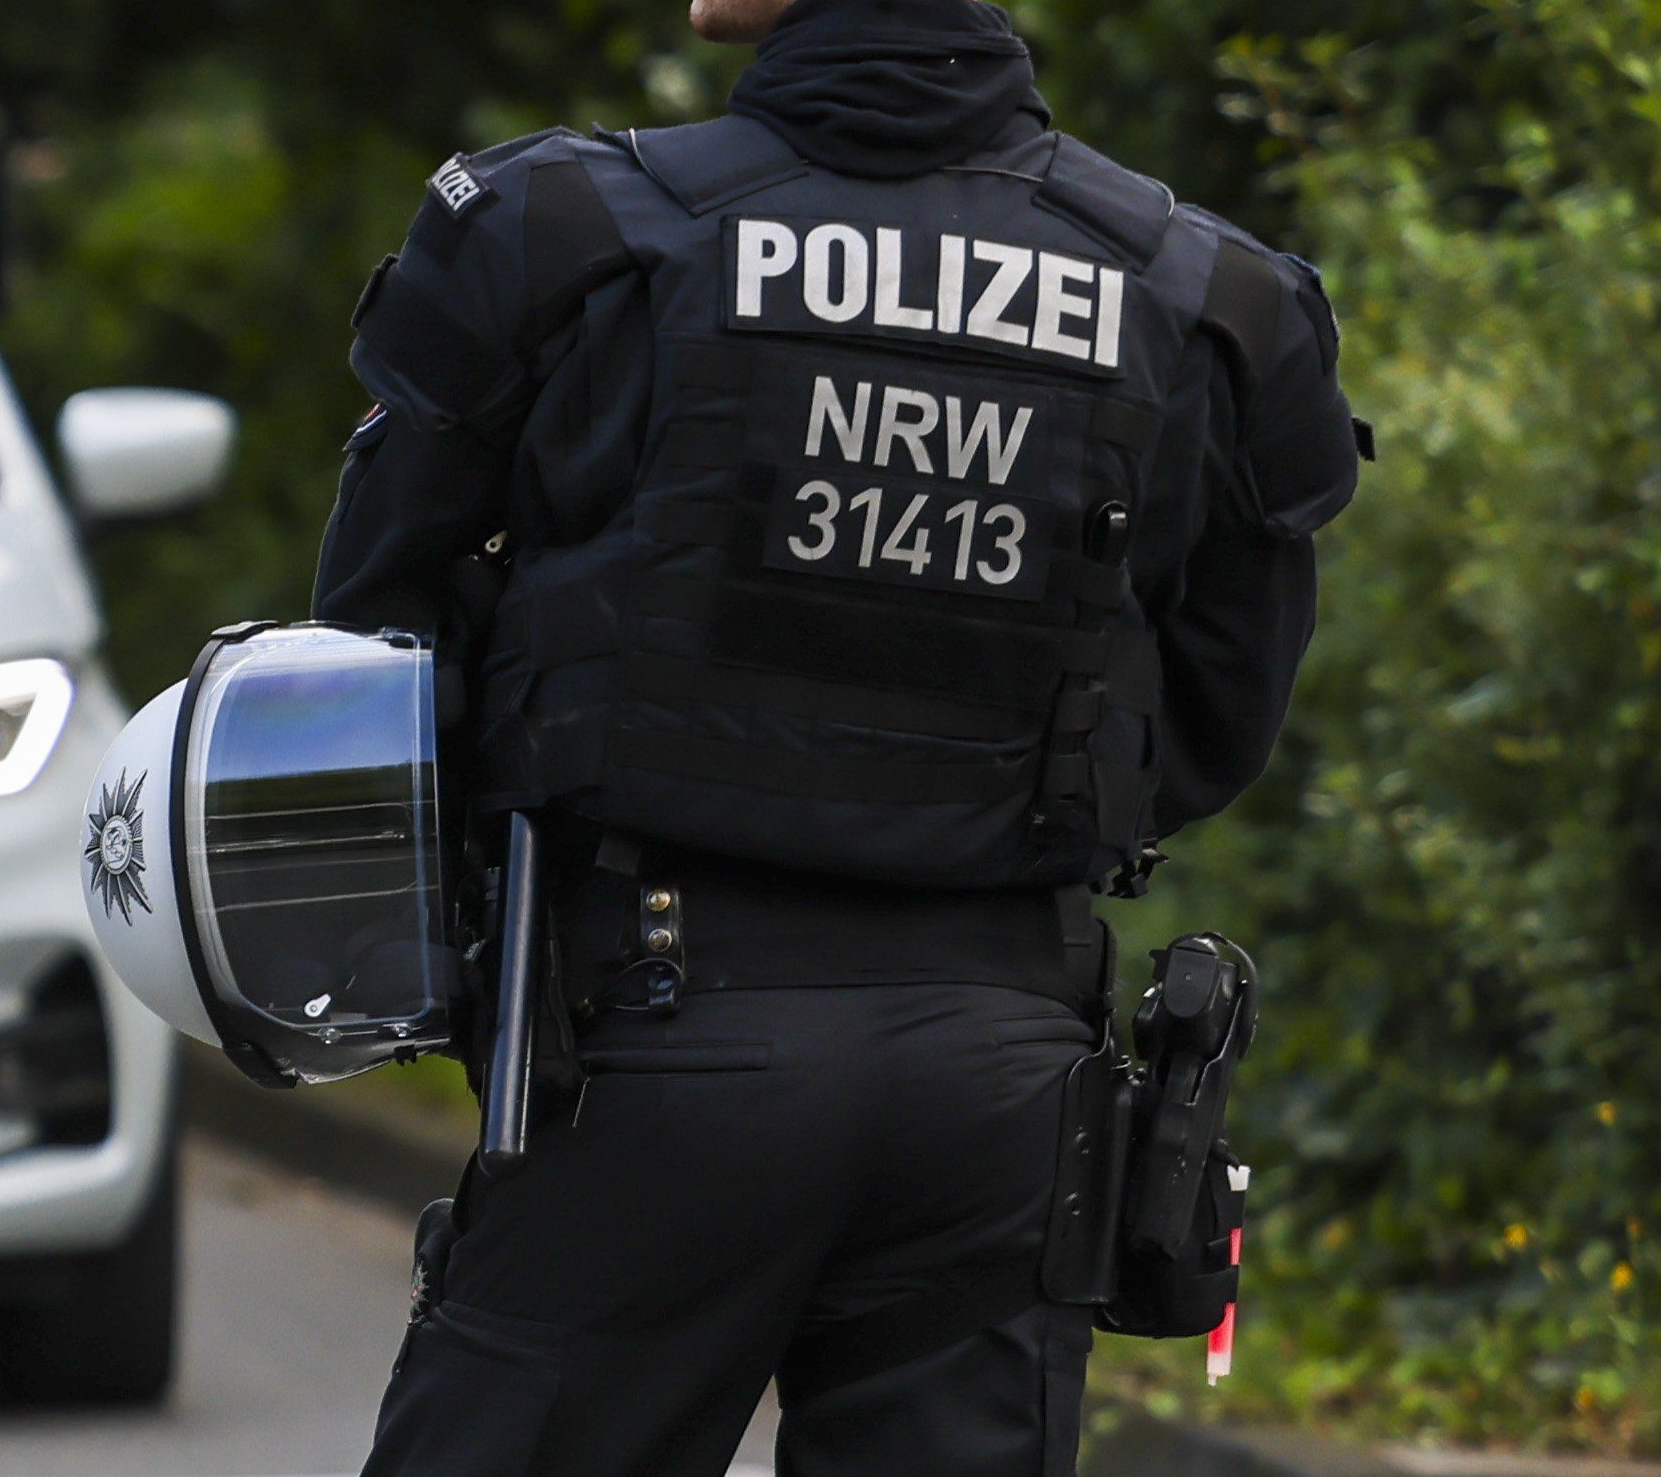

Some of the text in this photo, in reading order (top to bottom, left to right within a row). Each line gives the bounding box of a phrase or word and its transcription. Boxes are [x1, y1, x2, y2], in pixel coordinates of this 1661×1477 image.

[736, 219, 1124, 367] POLIZEI
[805, 376, 1033, 484] NRW
[788, 481, 1025, 584] 31413
